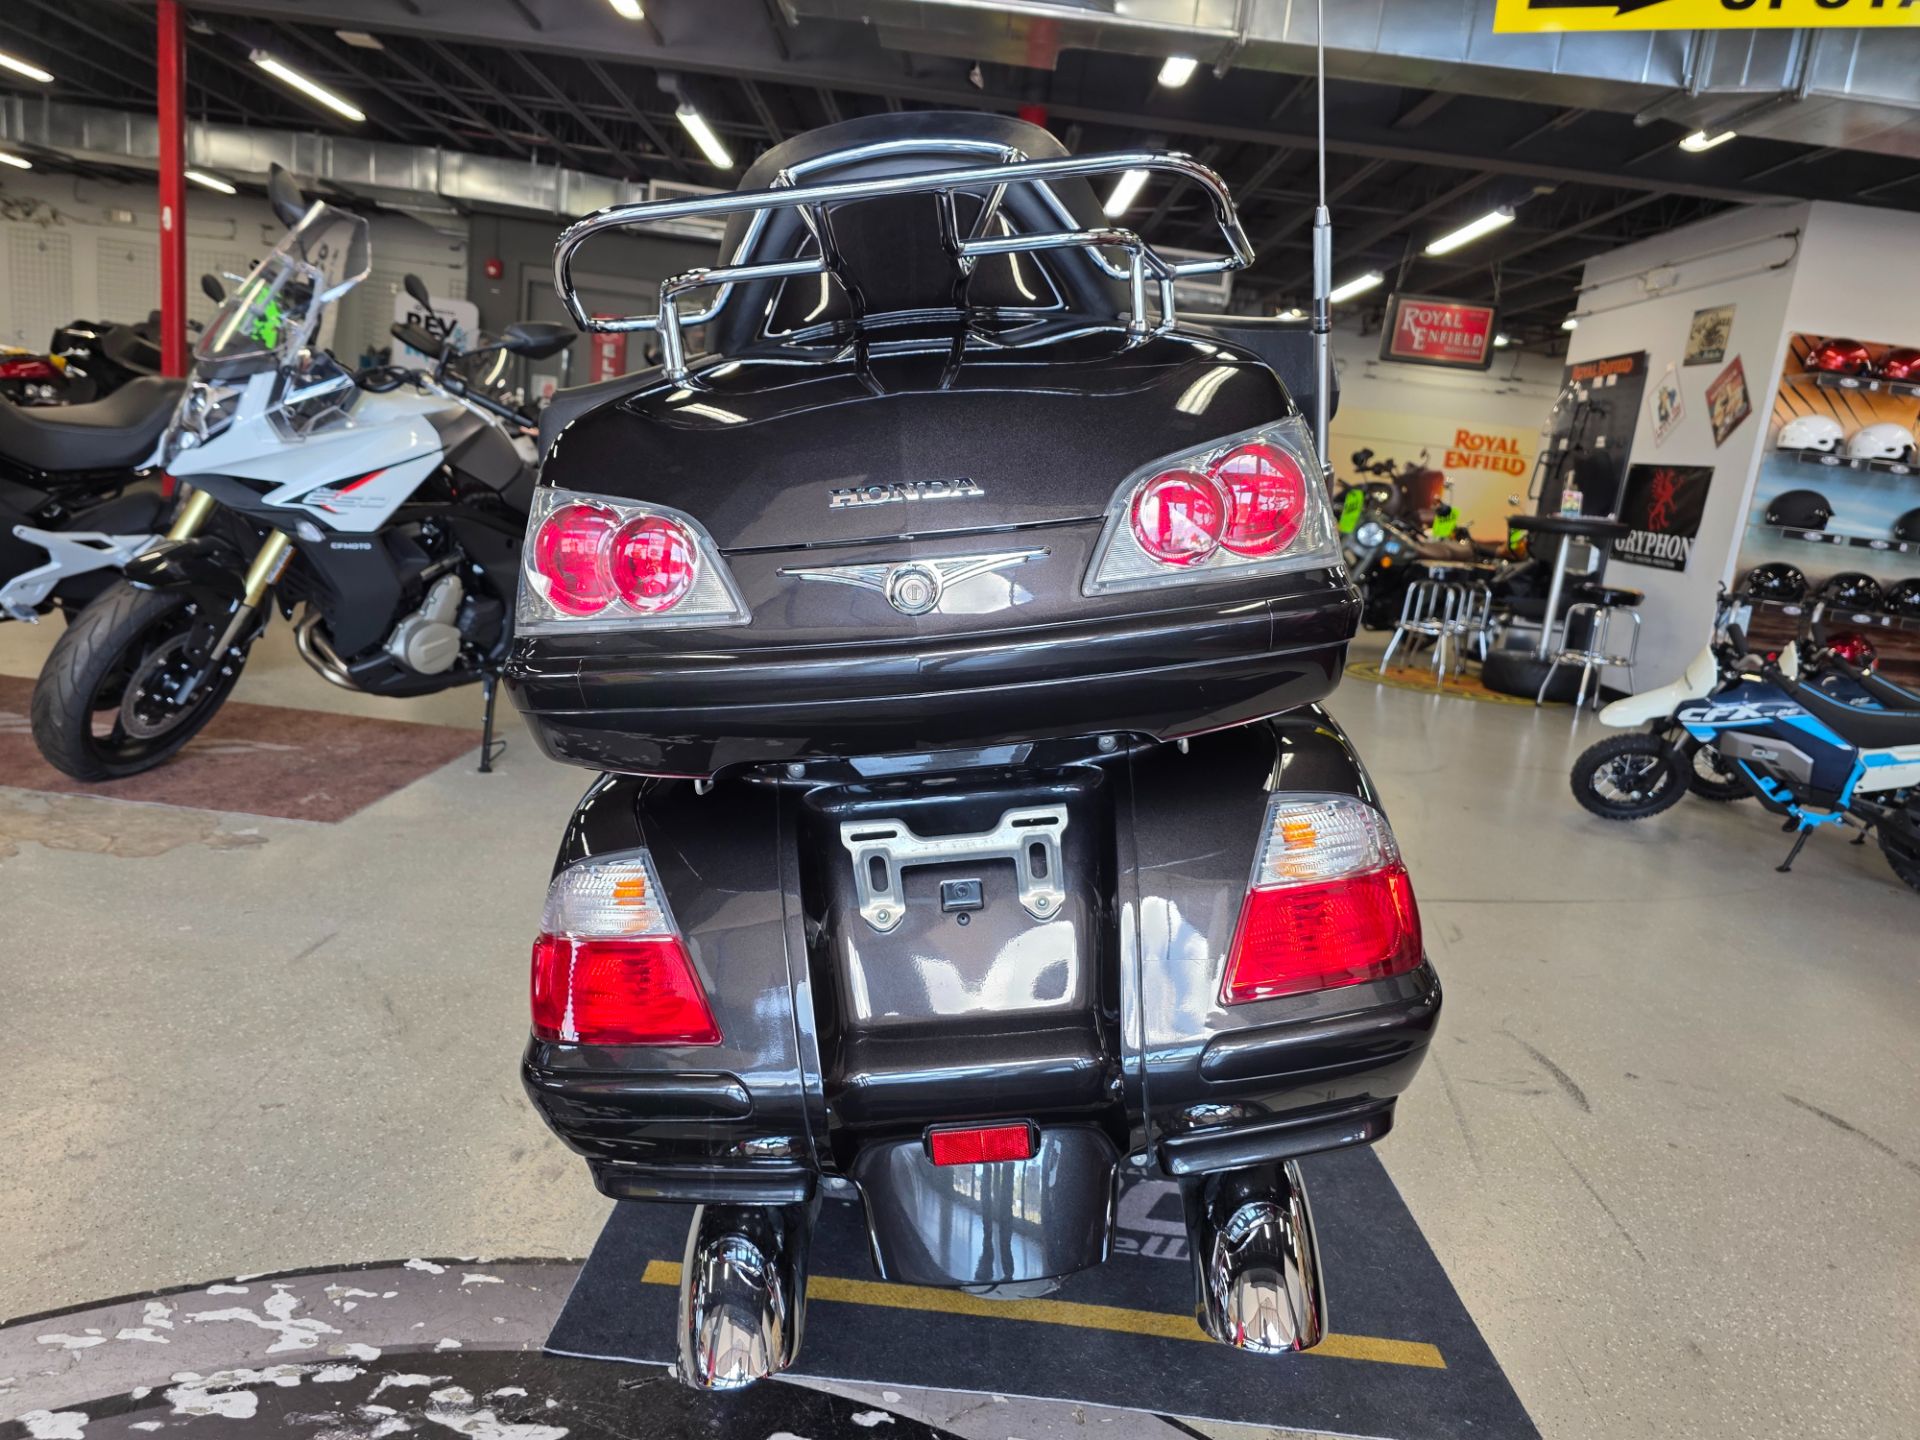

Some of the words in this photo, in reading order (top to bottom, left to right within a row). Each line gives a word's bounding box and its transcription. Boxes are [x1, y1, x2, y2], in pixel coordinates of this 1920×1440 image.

[1402, 307, 1464, 332] ROYAL
[1412, 327, 1484, 351] ENFIELD
[1455, 428, 1519, 455] ROYAL
[1443, 450, 1526, 477] ENFIELD
[829, 478, 985, 508] HONDA
[330, 542, 372, 550] CFMOTO
